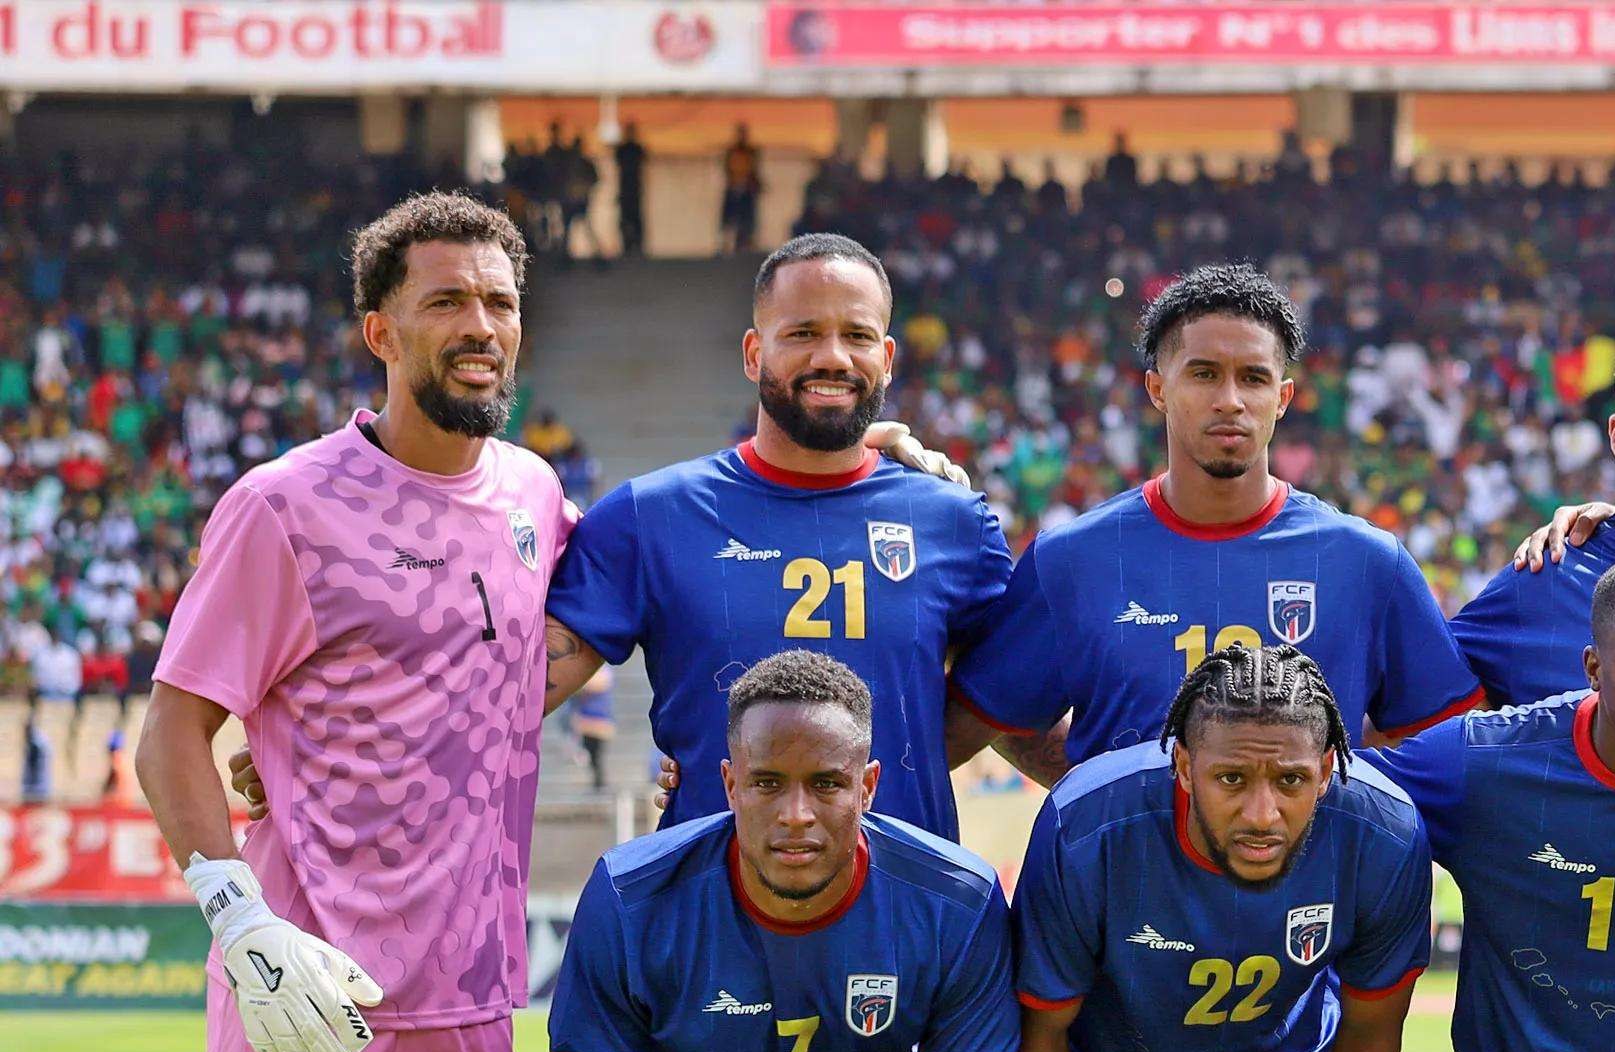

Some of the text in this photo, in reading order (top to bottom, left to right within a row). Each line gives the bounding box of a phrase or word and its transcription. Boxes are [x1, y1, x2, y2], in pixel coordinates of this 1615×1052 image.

[52, 3, 151, 59] du
[180, 2, 506, 60] Football
[871, 525, 908, 537] FCF
[406, 556, 446, 571] tempo
[736, 550, 782, 562] tempo
[1271, 584, 1312, 596] FCF
[470, 571, 497, 641] 1
[782, 557, 866, 640] 21
[1135, 612, 1179, 626] tempo
[1174, 624, 1263, 675] 1
[1549, 859, 1596, 875] tempo
[1290, 906, 1330, 922] FCF
[1150, 939, 1195, 952] tempo
[851, 979, 893, 990] FCF
[1183, 954, 1281, 1026] 22
[726, 1002, 772, 1016] tempo
